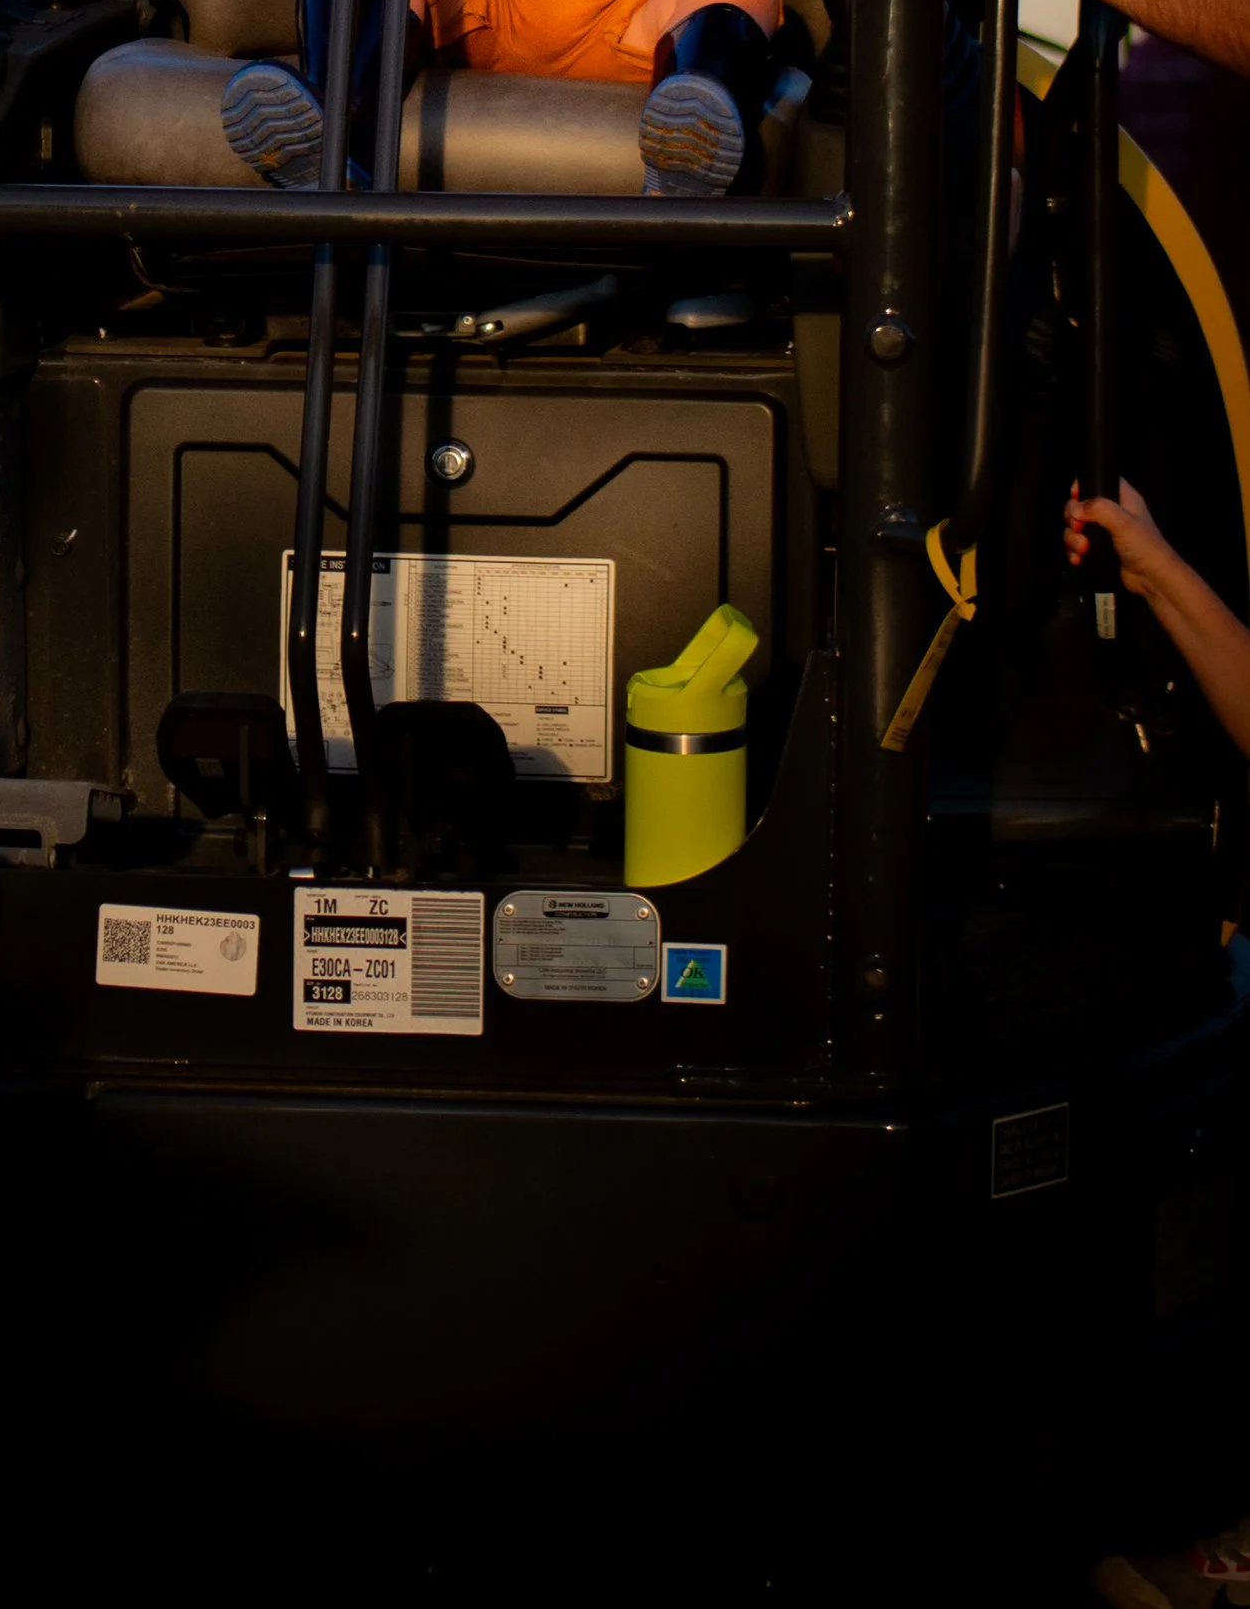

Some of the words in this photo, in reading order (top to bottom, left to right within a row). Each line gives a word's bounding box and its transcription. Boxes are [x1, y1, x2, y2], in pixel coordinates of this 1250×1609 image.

[314, 898, 338, 914] 1M
[369, 899, 389, 916] ZC
[156, 913, 256, 930] HHKHEK23EE0003
[156, 925, 175, 935] 128
[312, 985, 344, 1001] 3128
[306, 1016, 331, 1026] MADE
[333, 1017, 342, 1027] IN
[344, 1018, 374, 1028] KOREA
